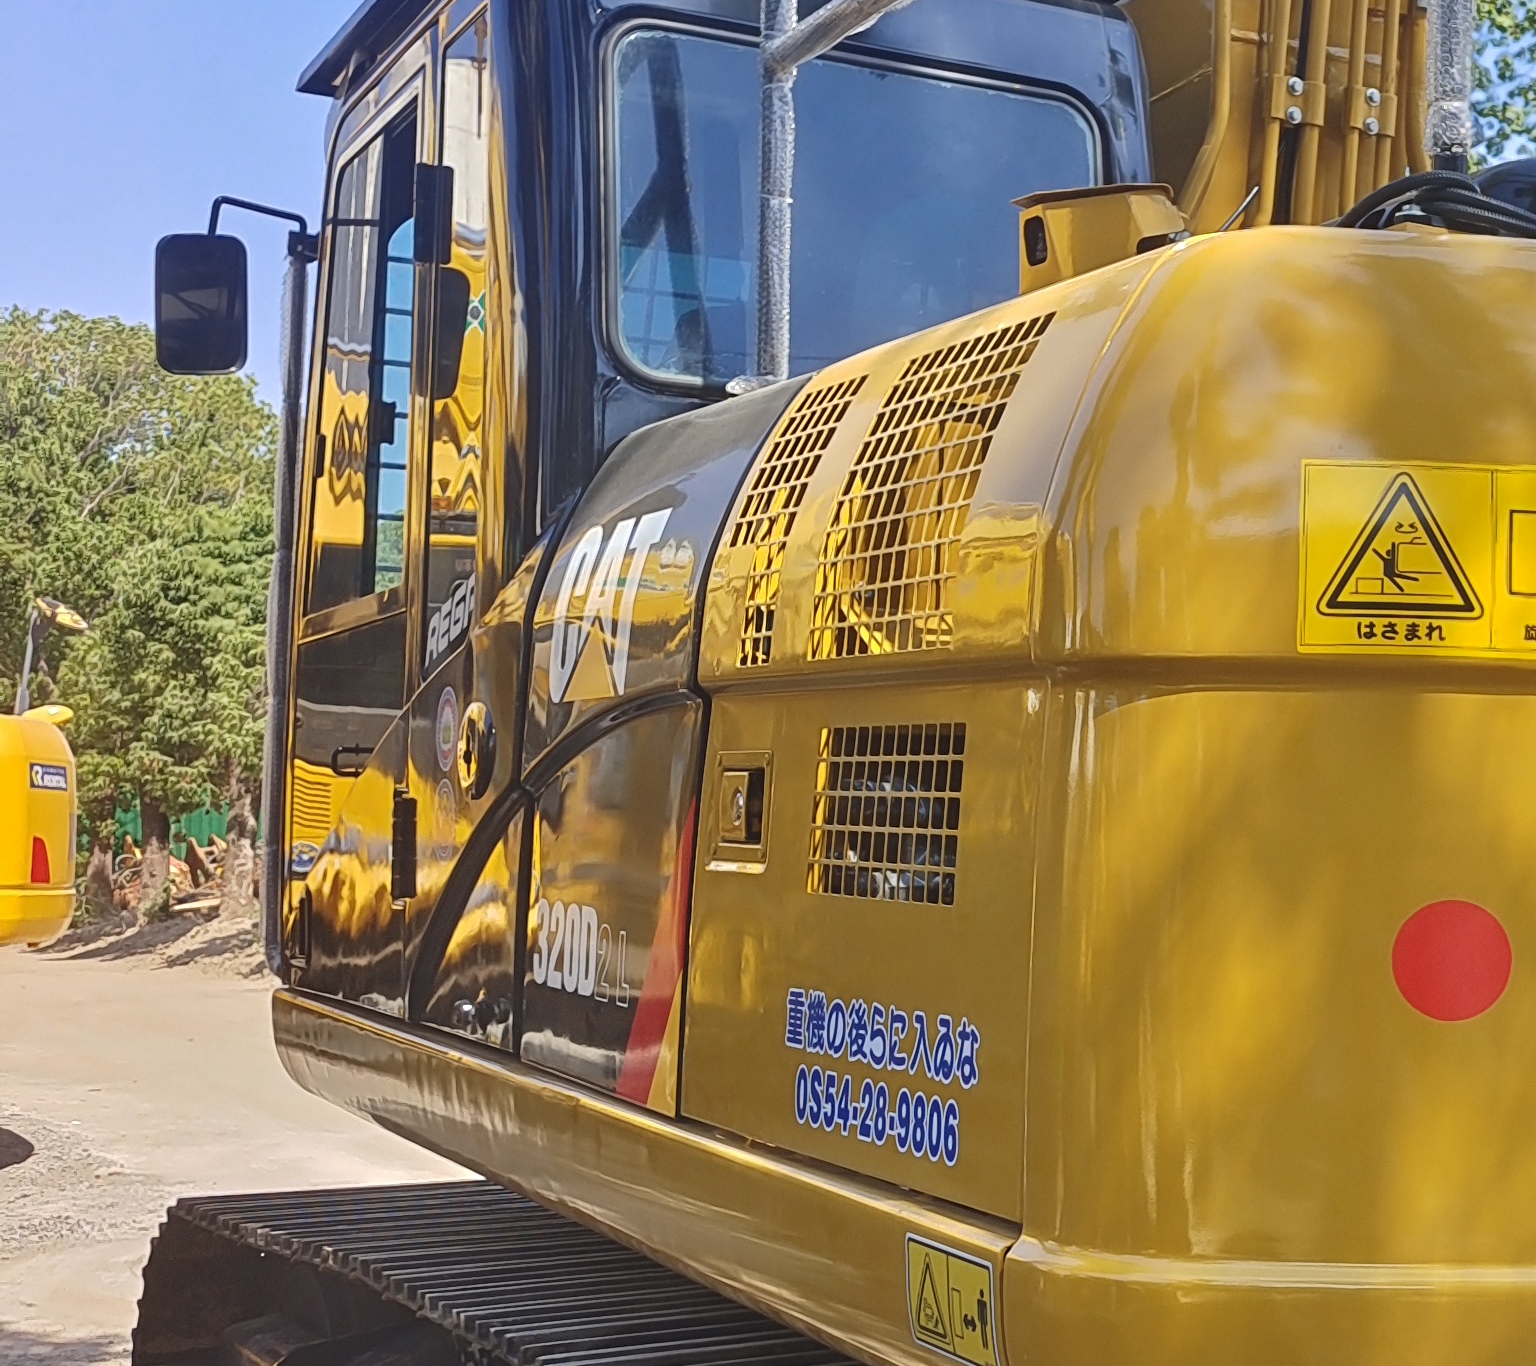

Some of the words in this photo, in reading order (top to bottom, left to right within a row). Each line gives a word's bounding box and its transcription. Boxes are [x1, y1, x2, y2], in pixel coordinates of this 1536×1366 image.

[549, 506, 674, 704] CAT
[1356, 620, 1447, 642] はさまれ
